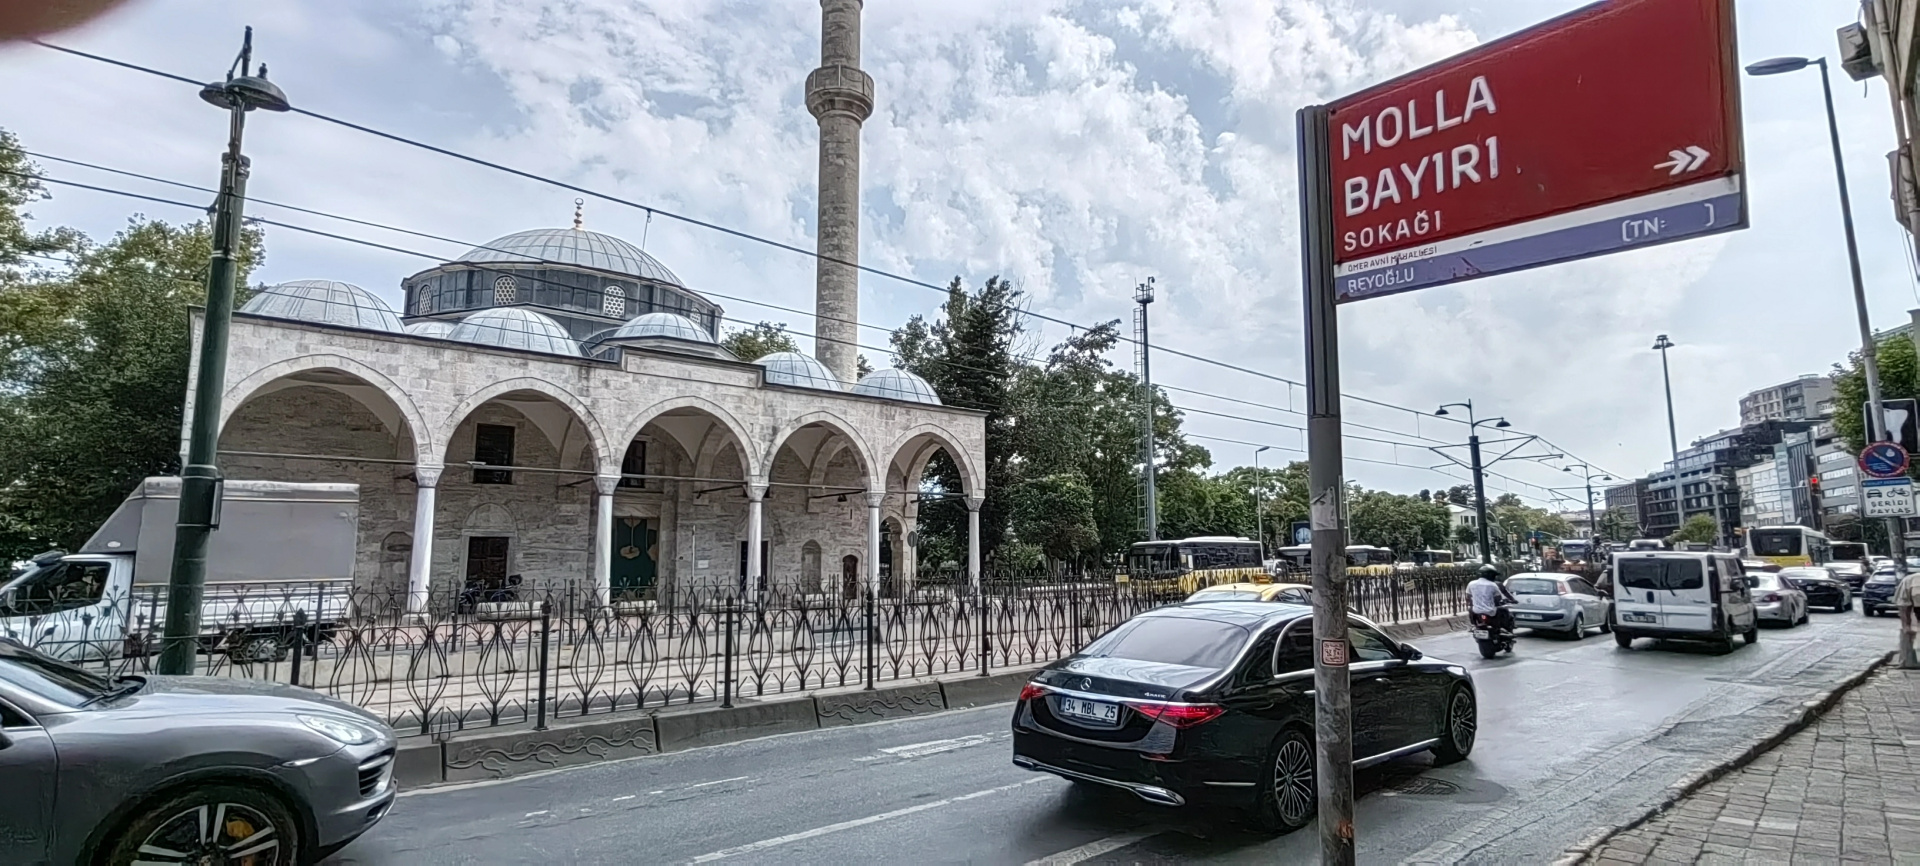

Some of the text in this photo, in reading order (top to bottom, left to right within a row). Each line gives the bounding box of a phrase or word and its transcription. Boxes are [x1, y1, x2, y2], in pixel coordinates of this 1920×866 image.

[1342, 75, 1497, 161] MOLLA
[1344, 136, 1499, 217] BAYIRI
[1344, 210, 1441, 251] SOKAĞI
[1065, 699, 1117, 719] 34 MBL 25
